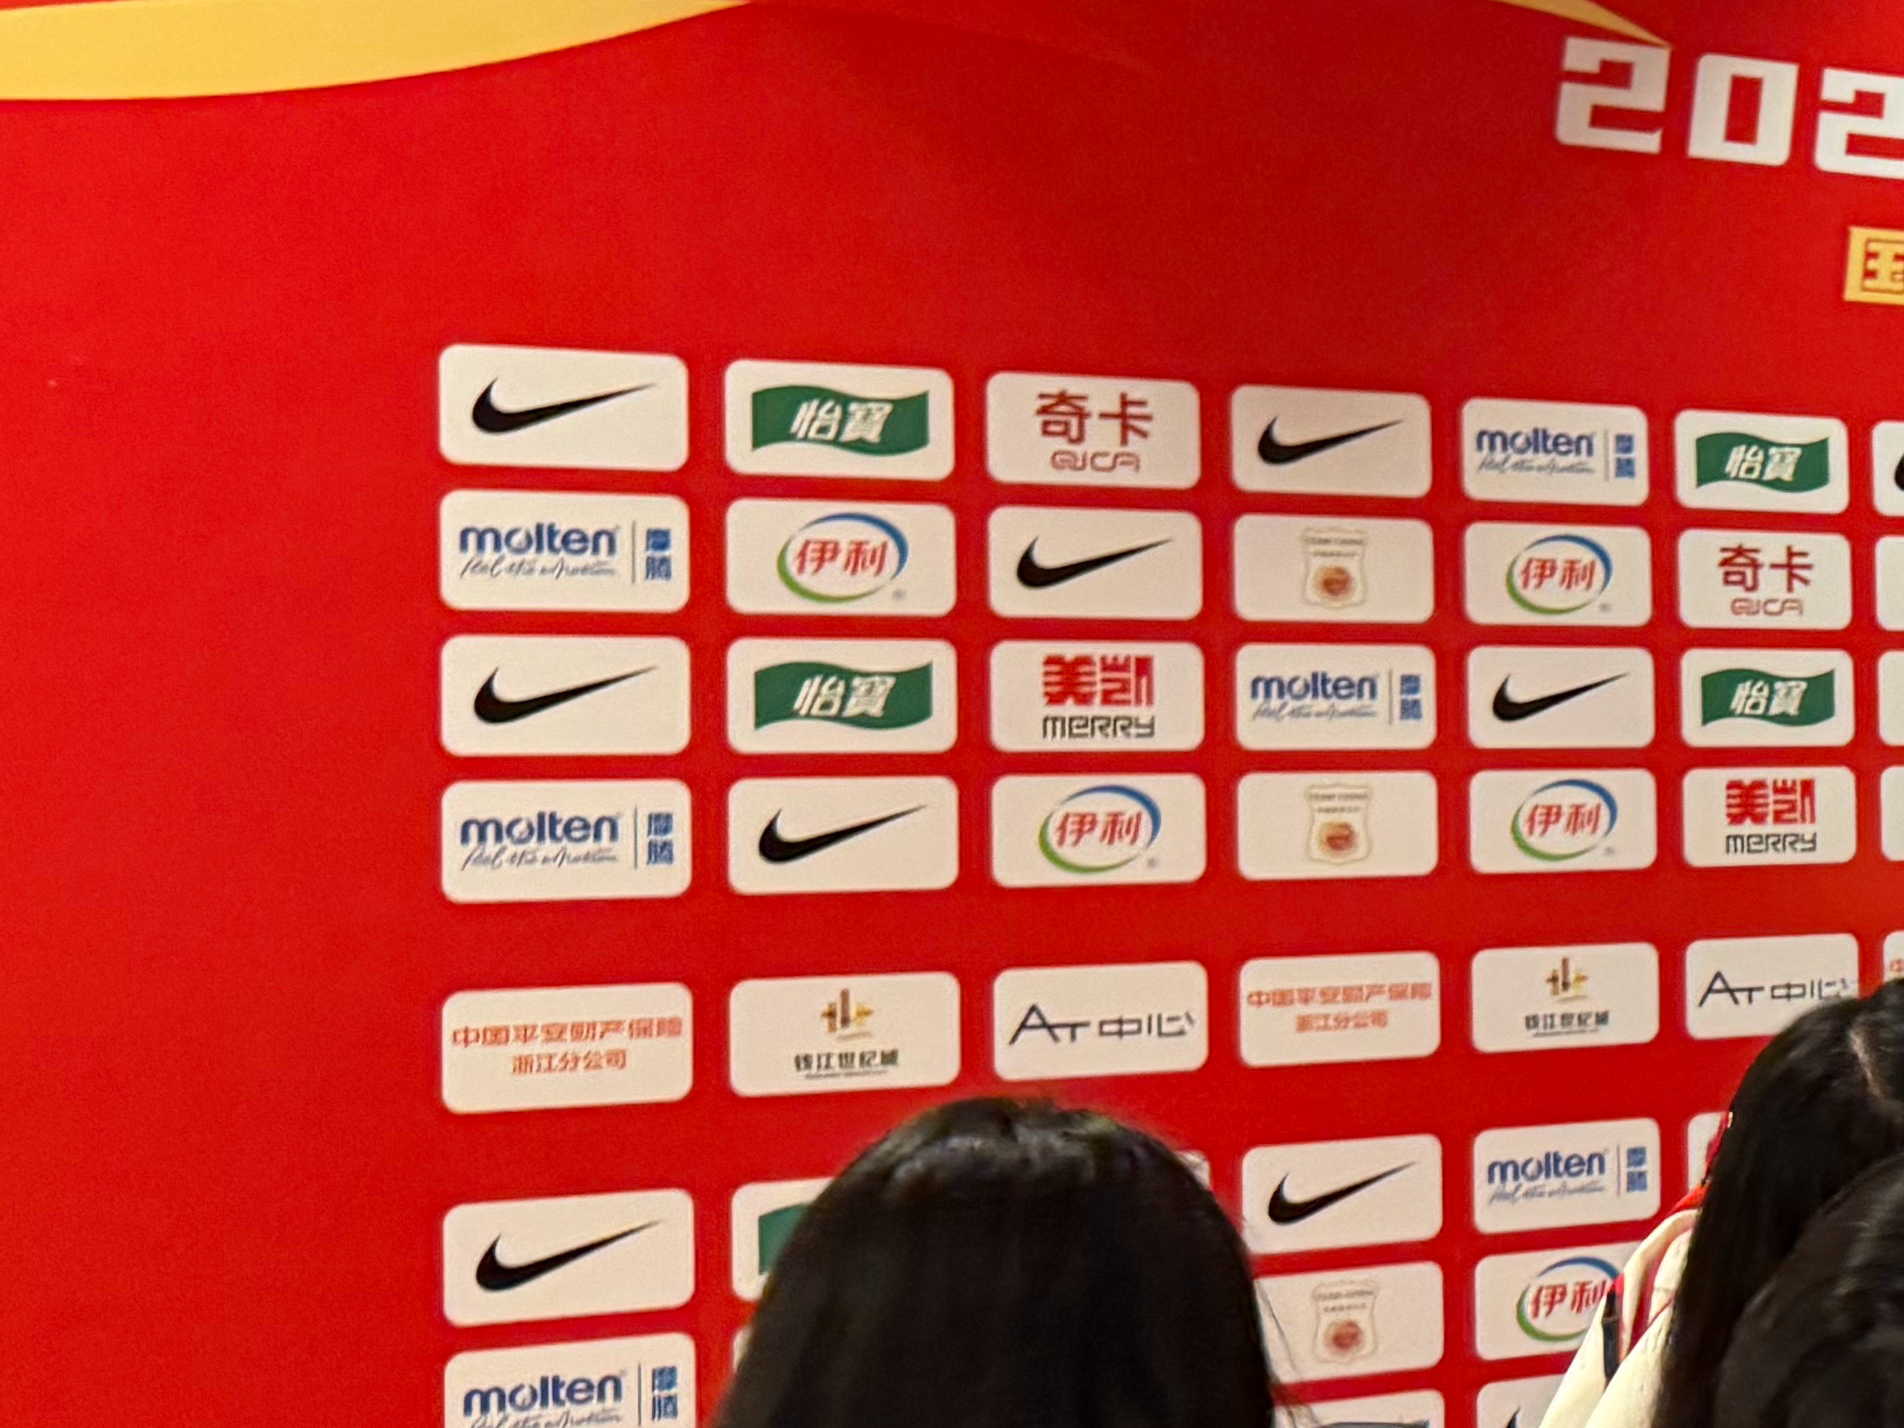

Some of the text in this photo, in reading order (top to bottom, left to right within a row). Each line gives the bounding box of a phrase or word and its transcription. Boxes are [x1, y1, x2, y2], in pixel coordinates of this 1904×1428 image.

[790, 399, 894, 443] 怡寶
[1035, 390, 1153, 446] 奇卡
[1476, 427, 1594, 458] molten
[459, 522, 617, 556] molten
[797, 539, 888, 577] 伊利
[1522, 558, 1596, 590] 伊利
[1718, 544, 1813, 593] 奇卡
[793, 675, 897, 718] 怡寶
[1042, 654, 1154, 706] 美凯
[1251, 671, 1377, 701] molten
[1042, 715, 1155, 740] MERRY
[1527, 803, 1601, 837] 伊利
[1726, 778, 1816, 826] 美凯
[460, 811, 619, 846] molten
[1057, 811, 1142, 848] 伊利
[1487, 1150, 1605, 1184] molten
[463, 1375, 622, 1418] molten
